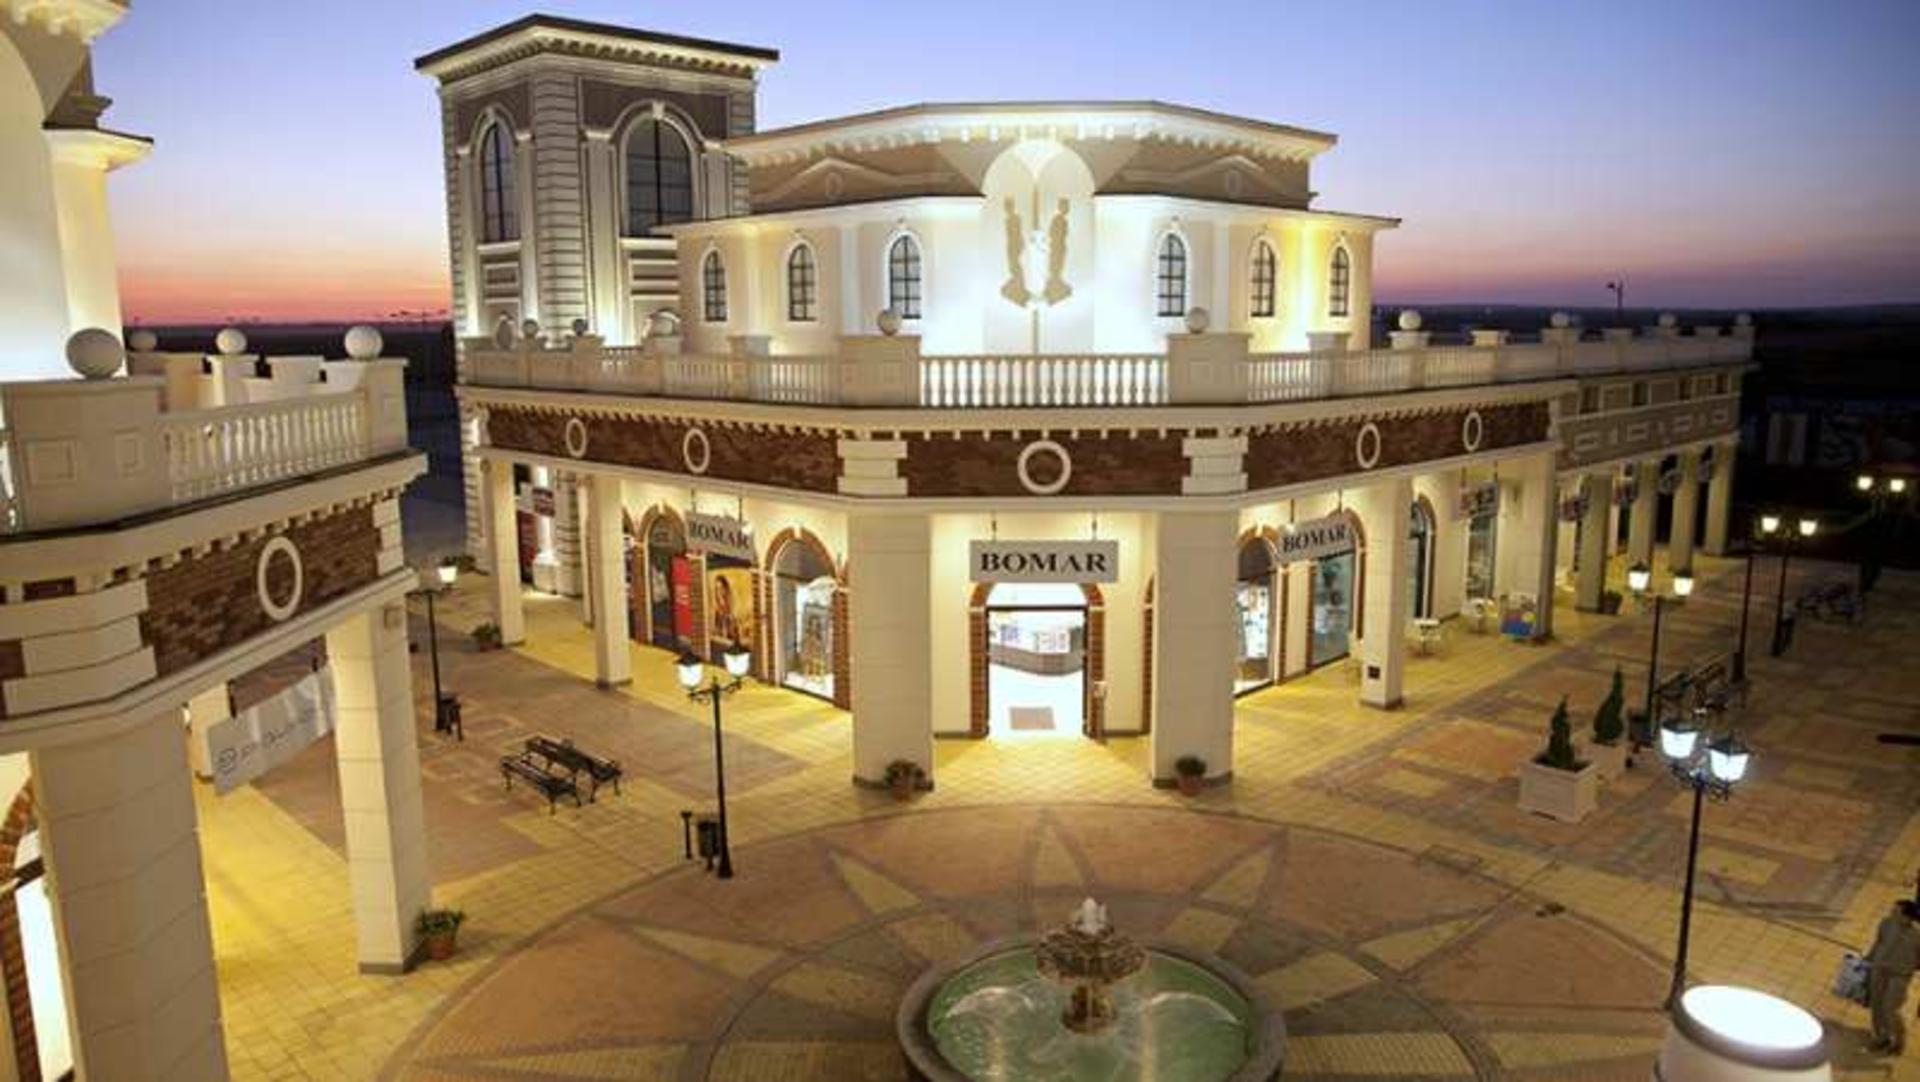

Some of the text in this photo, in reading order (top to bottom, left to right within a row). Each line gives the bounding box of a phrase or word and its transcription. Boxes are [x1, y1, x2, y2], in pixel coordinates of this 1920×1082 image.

[689, 520, 750, 550] BOMAR
[1283, 523, 1345, 550] BOMAR
[980, 552, 1107, 573] BOMAR
